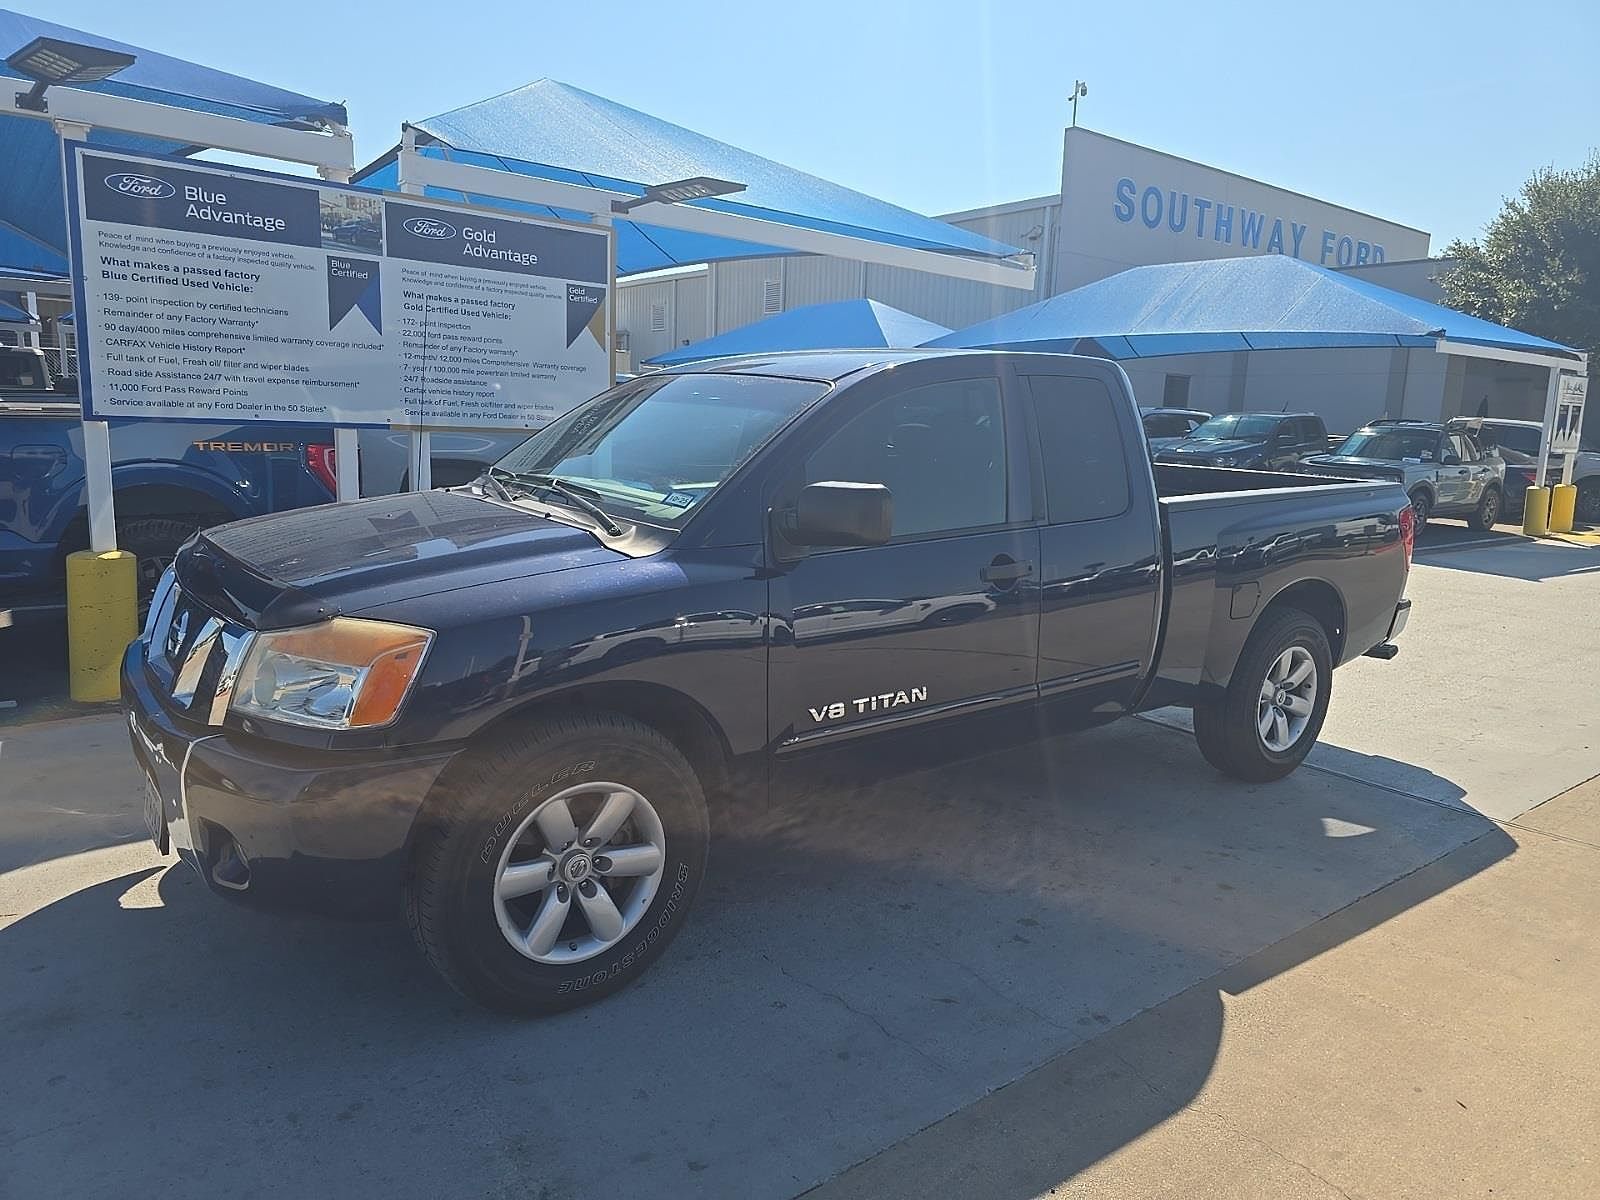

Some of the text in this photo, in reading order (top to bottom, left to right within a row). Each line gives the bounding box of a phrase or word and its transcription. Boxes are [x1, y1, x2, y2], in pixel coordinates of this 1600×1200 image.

[119, 174, 162, 197] Ford
[184, 186, 226, 205] Blue
[184, 204, 286, 232] Advantage
[1113, 177, 1385, 265] SOUTHWAY FORD
[414, 219, 446, 237] Ford
[463, 228, 496, 243] Gold
[331, 259, 350, 269] Blue
[463, 244, 538, 266] Advantage
[100, 255, 130, 267] What
[133, 261, 170, 271] makes
[183, 266, 221, 276] passed
[224, 269, 260, 282] factory
[331, 268, 368, 279] Certified
[102, 270, 253, 292] Blue Certified Used Vehicle:
[568, 286, 584, 295] Gold
[569, 294, 597, 303] Certified
[103, 292, 288, 315] 139- point inspection by certified technicians
[403, 290, 424, 299] What
[425, 294, 452, 302] makes
[460, 298, 487, 306] passed
[490, 300, 515, 310] factory
[403, 302, 423, 311] Gold
[425, 304, 458, 314] Certified
[460, 308, 479, 316] Used
[103, 307, 152, 318] Remainder
[166, 314, 182, 322] any
[184, 314, 216, 325] Factory
[104, 322, 116, 330] 90
[118, 323, 160, 333] day/4000
[162, 327, 185, 335] miles
[187, 330, 250, 340] comprehensive
[252, 334, 278, 342] limited
[280, 337, 313, 346] warranty
[315, 340, 350, 348] coverage
[105, 338, 146, 347] CARFAX
[148, 341, 180, 349] Vehicle
[182, 343, 211, 353] History
[106, 352, 123, 361] Full
[125, 354, 144, 362] tank
[146, 355, 156, 363] of
[158, 356, 180, 365] Fuel,
[182, 357, 206, 366] Fresh
[223, 360, 241, 368] filter
[260, 363, 281, 371] wiper
[283, 364, 309, 372] blades
[107, 368, 131, 376] Road
[134, 369, 152, 377] side
[154, 370, 201, 379] Assistance
[242, 375, 264, 383] travel
[141, 384, 161, 392] Ford
[164, 385, 185, 393] Pass
[188, 386, 220, 394] Reward
[109, 397, 143, 405] Service
[145, 399, 184, 407] available
[192, 440, 295, 452] TREMOR
[808, 686, 927, 722] V8 TITAN
[558, 862, 689, 993] BRIDGESTONE
